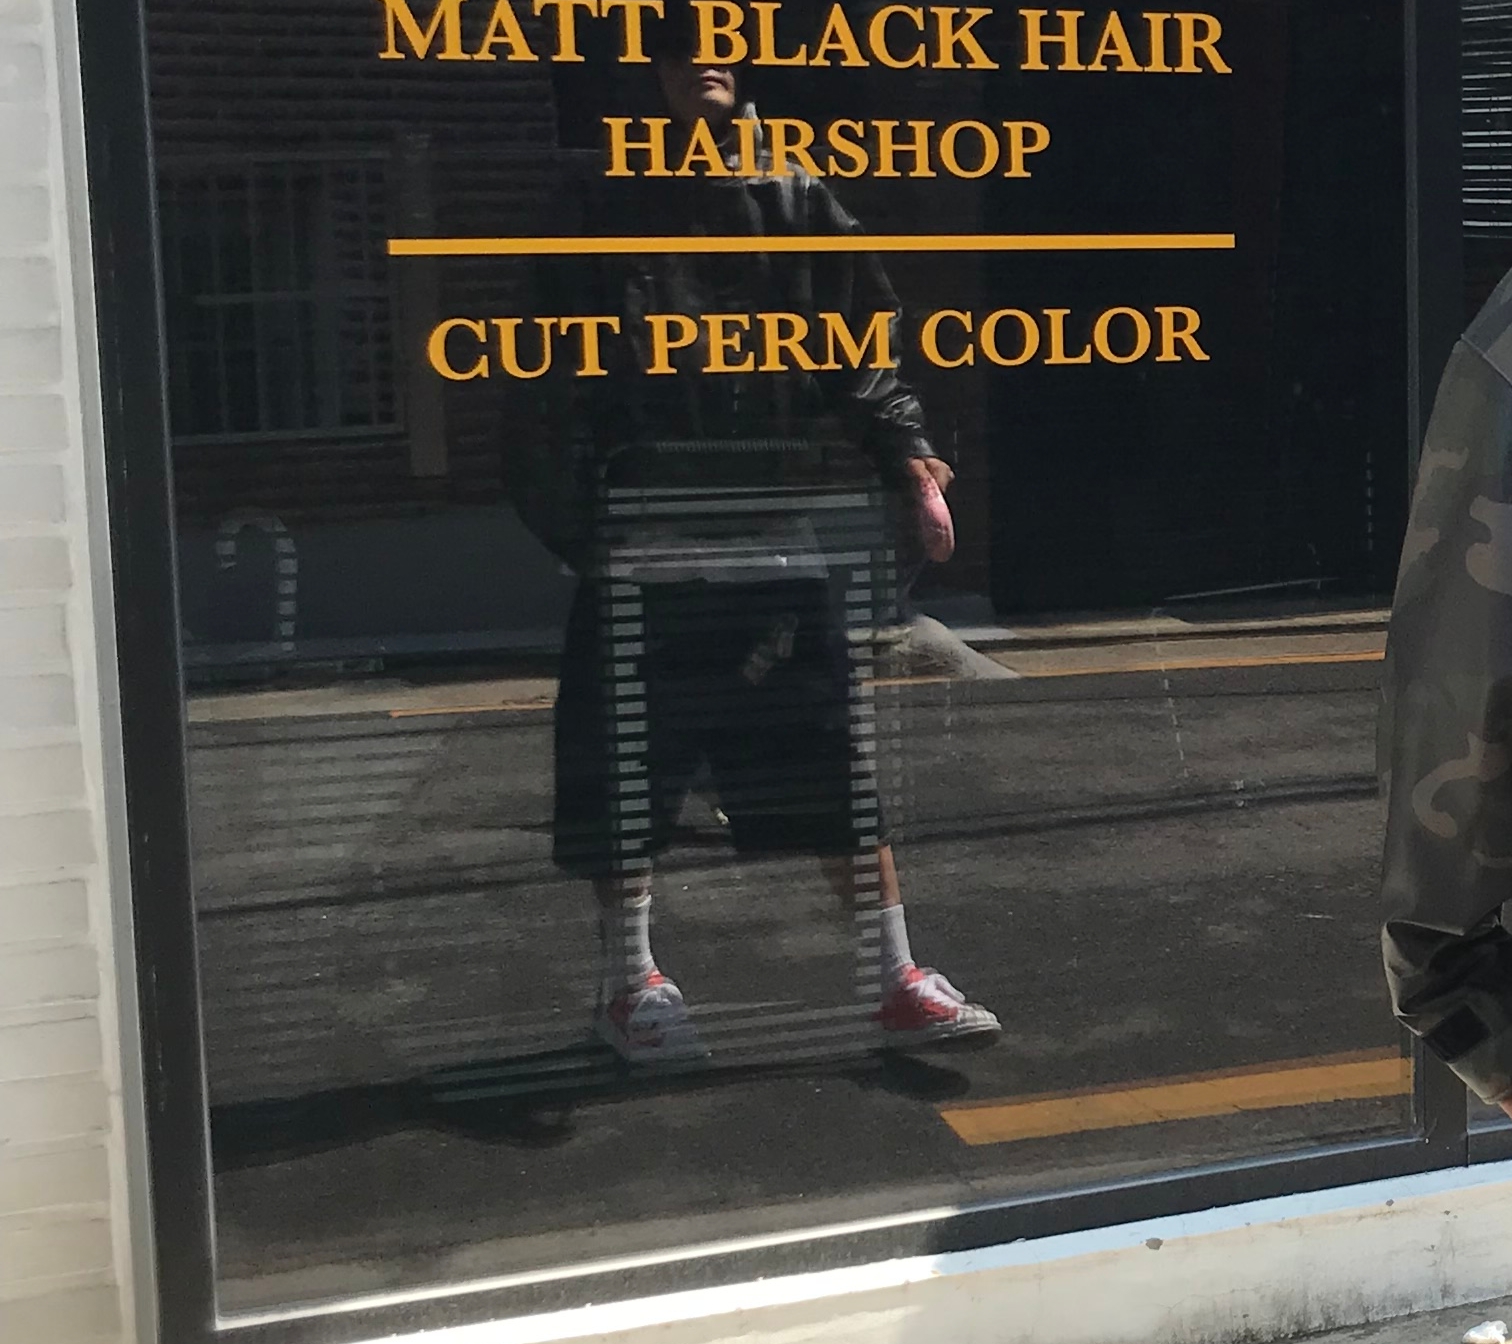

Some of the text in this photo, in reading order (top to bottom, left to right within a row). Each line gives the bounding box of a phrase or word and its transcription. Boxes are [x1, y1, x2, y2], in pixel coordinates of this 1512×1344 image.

[689, 0, 999, 70] BLACK
[1018, 8, 1232, 74] HAIR
[602, 117, 1051, 179] HAIRSHOP
[426, 306, 1210, 381] CUT PERM COLOR
